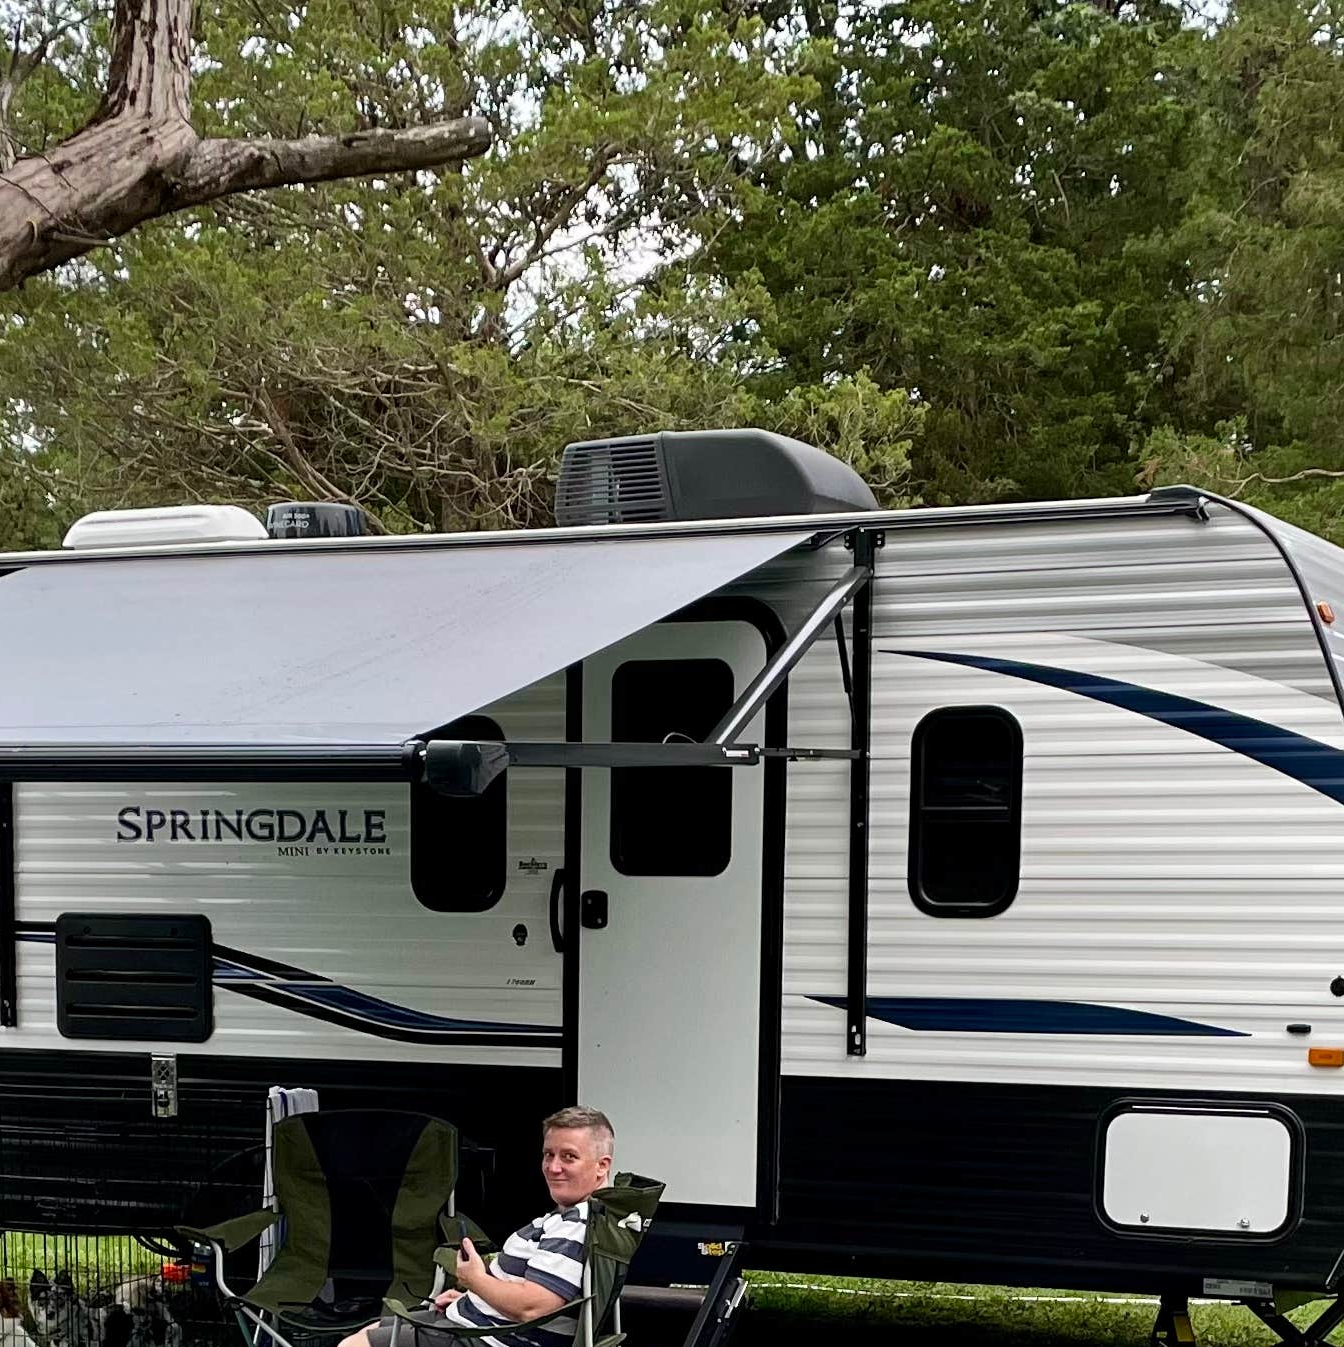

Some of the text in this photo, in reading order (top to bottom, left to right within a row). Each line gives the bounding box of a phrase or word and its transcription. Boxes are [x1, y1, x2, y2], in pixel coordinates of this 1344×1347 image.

[116, 805, 388, 844] SPRINGDALE
[277, 846, 392, 857] MINI BY KEYSTONE
